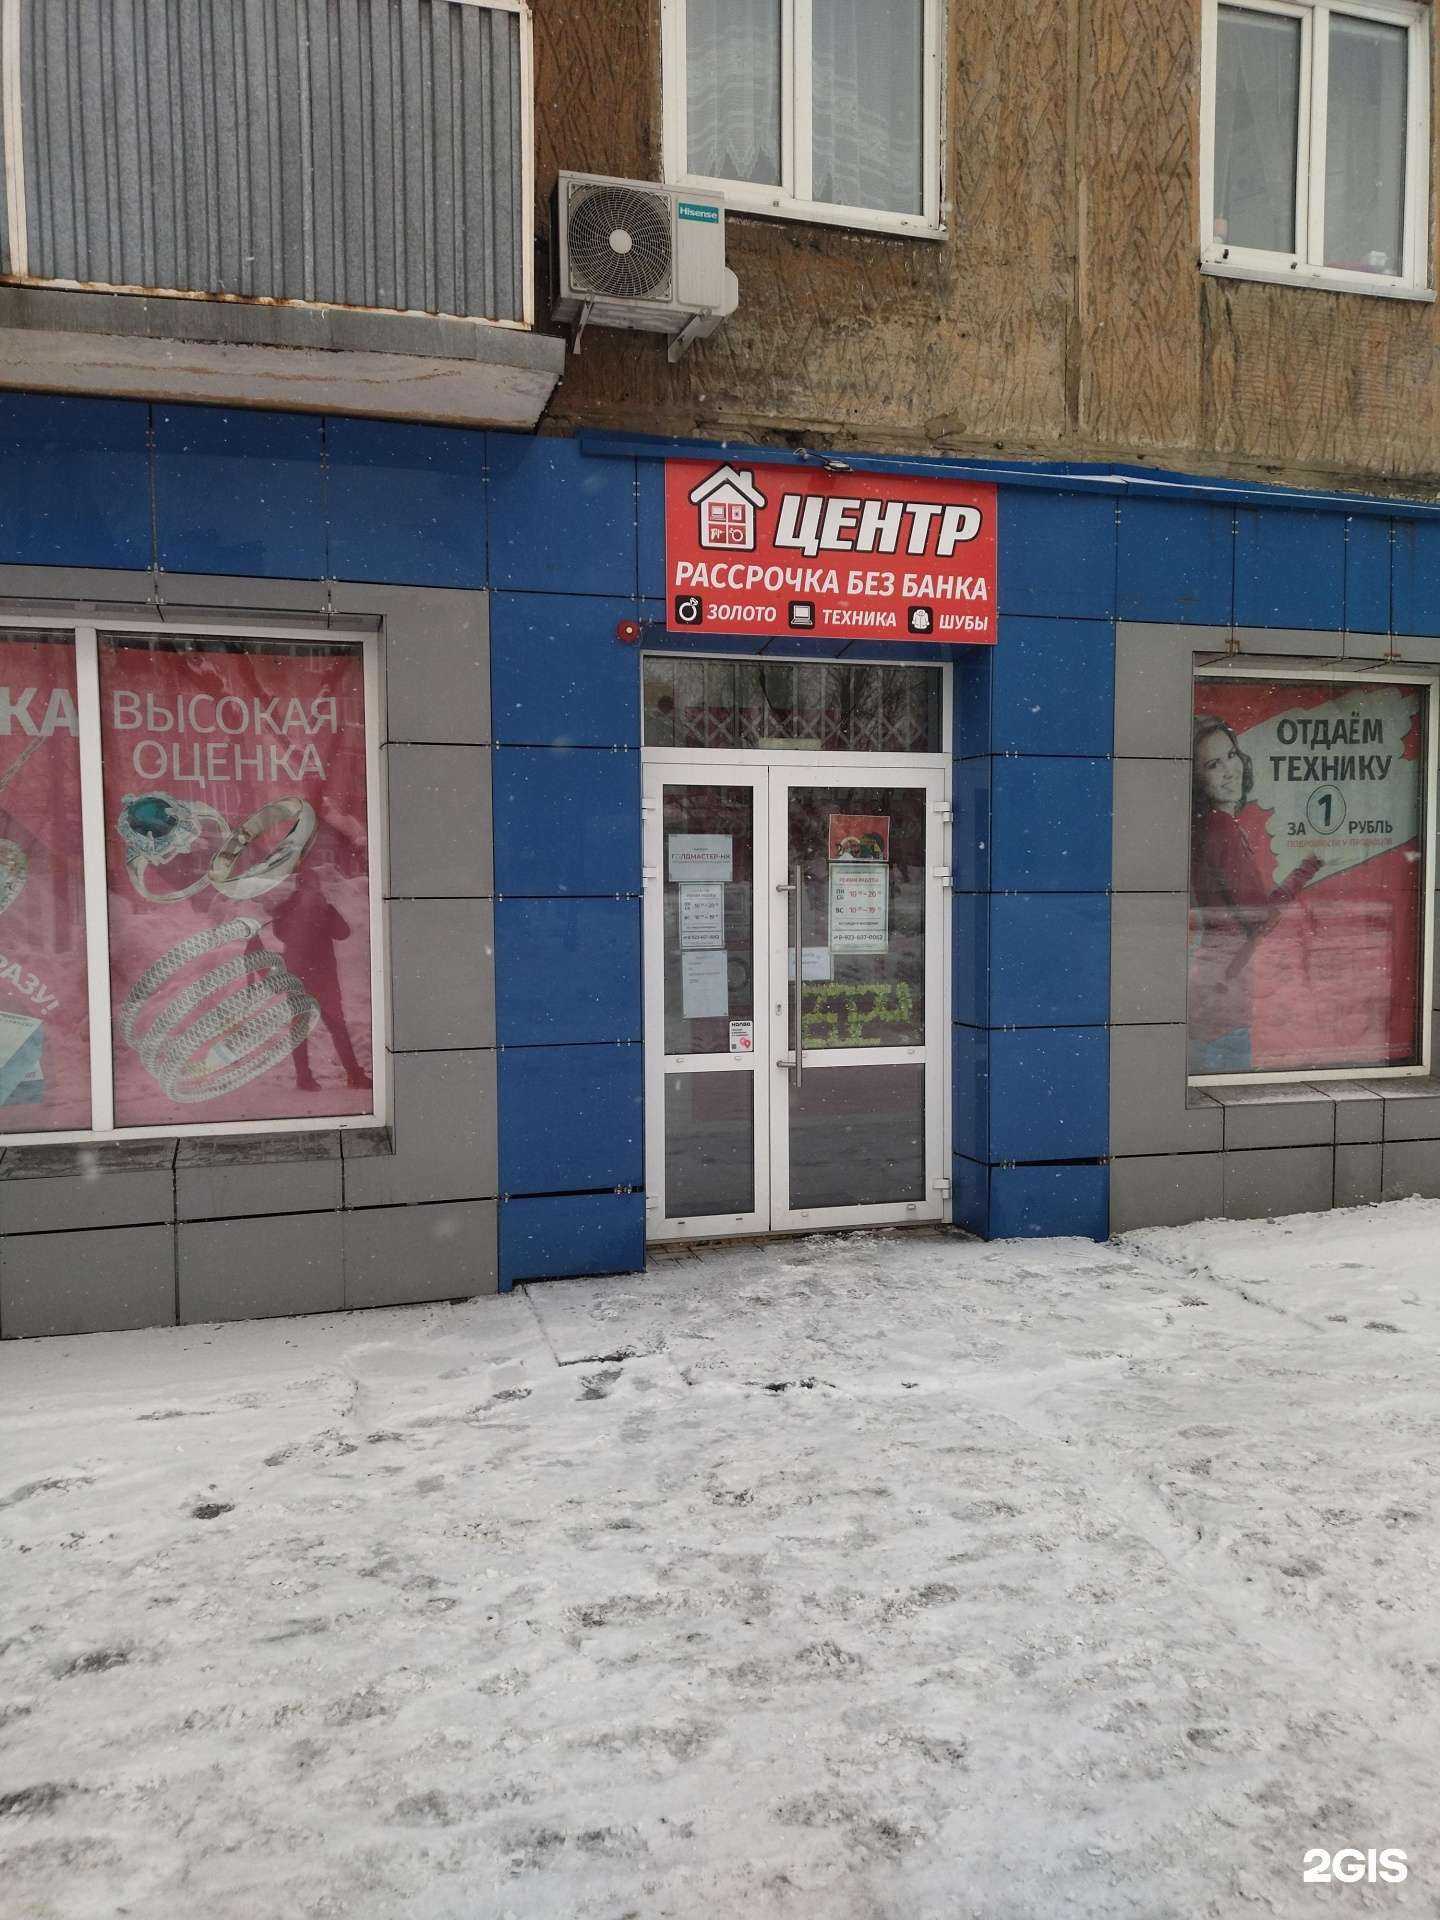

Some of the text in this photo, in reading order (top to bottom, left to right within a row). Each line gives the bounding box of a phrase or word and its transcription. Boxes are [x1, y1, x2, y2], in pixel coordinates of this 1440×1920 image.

[680, 206, 718, 219] Hisense
[774, 494, 983, 557] ЦЕНТР
[675, 561, 988, 600] РАССРОЧКА БЕЗ БАНКА
[707, 604, 988, 631] ЗОЛОТО ТЕХНИКА ШУБЫ
[112, 690, 339, 735] ВЫСОКАЯ
[1277, 711, 1384, 750] ОТДАЁМ
[132, 740, 327, 787] ОЦЕНКА
[1269, 755, 1393, 782] ТЕХНИКУ
[1287, 794, 1393, 836] ЗА 1 РУБЛЬ
